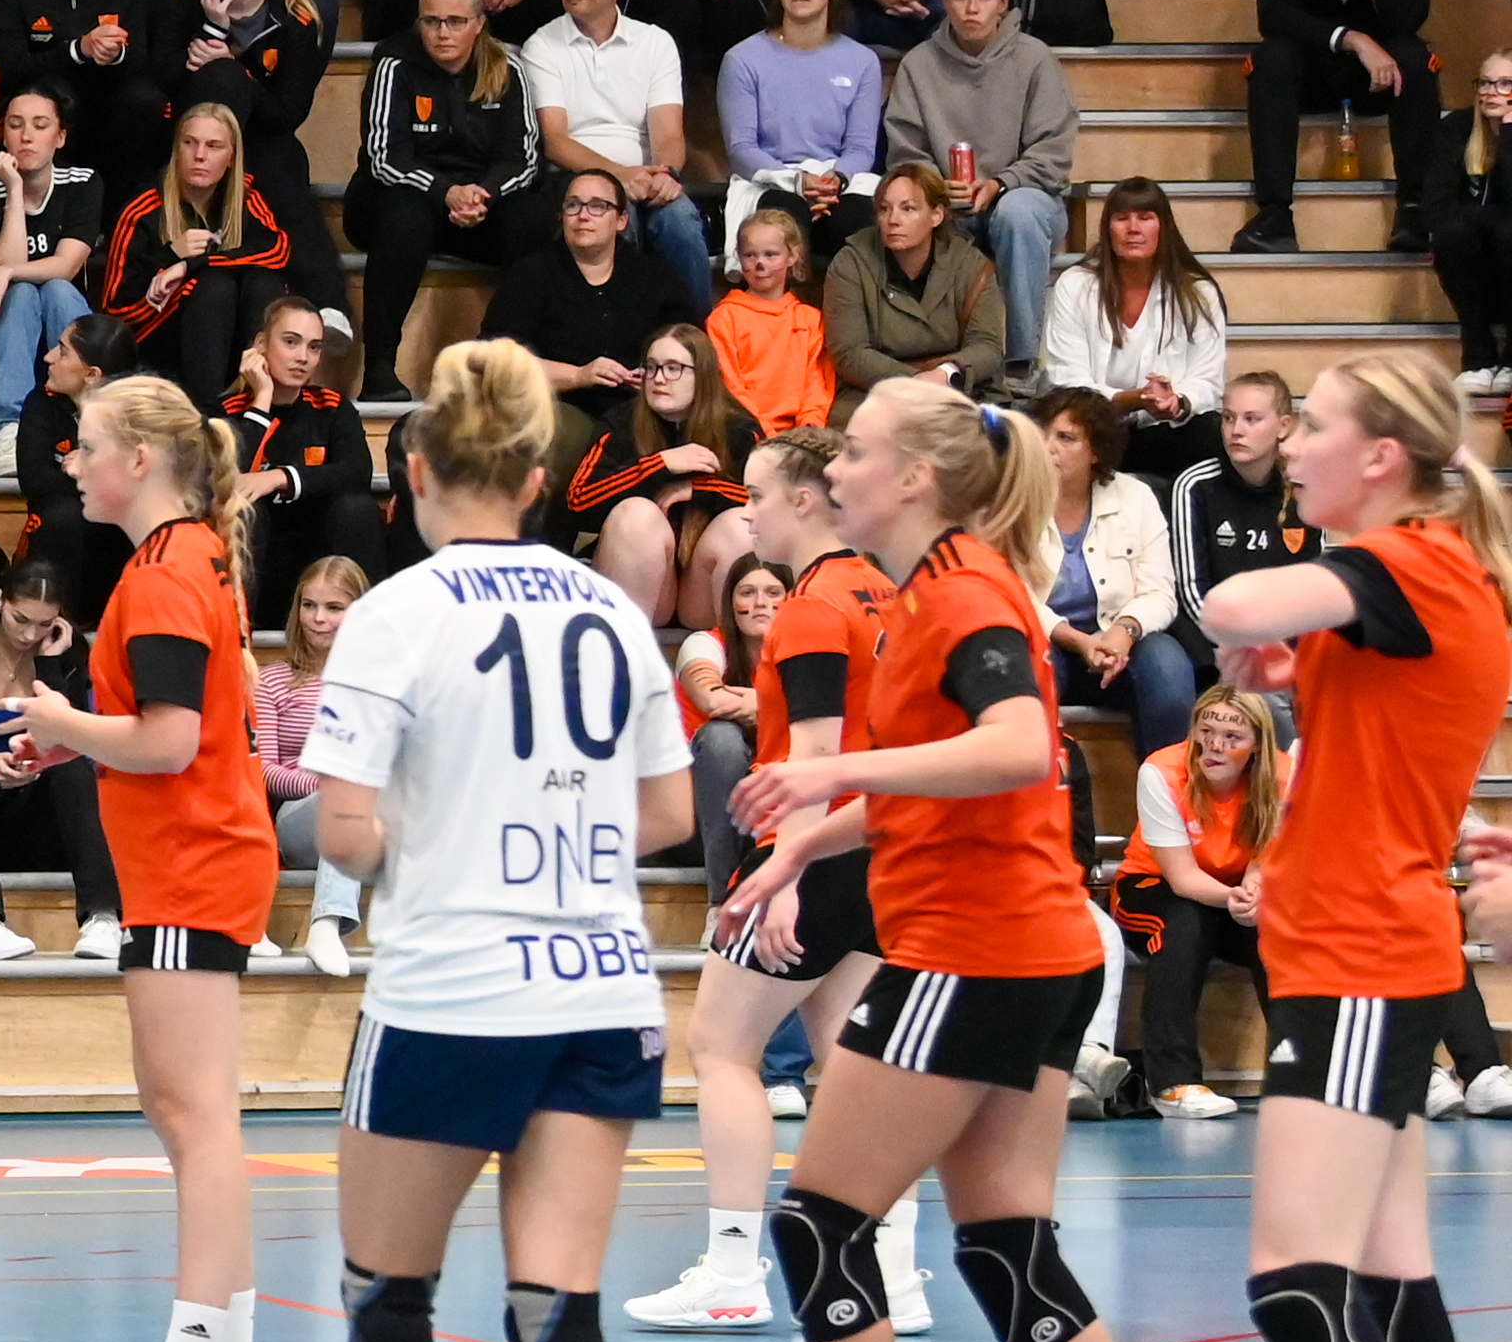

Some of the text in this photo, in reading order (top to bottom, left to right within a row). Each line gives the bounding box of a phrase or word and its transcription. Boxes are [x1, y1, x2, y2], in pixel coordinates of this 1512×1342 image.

[26, 232, 49, 256] 38
[1246, 530, 1269, 550] 24
[475, 612, 632, 761] 10
